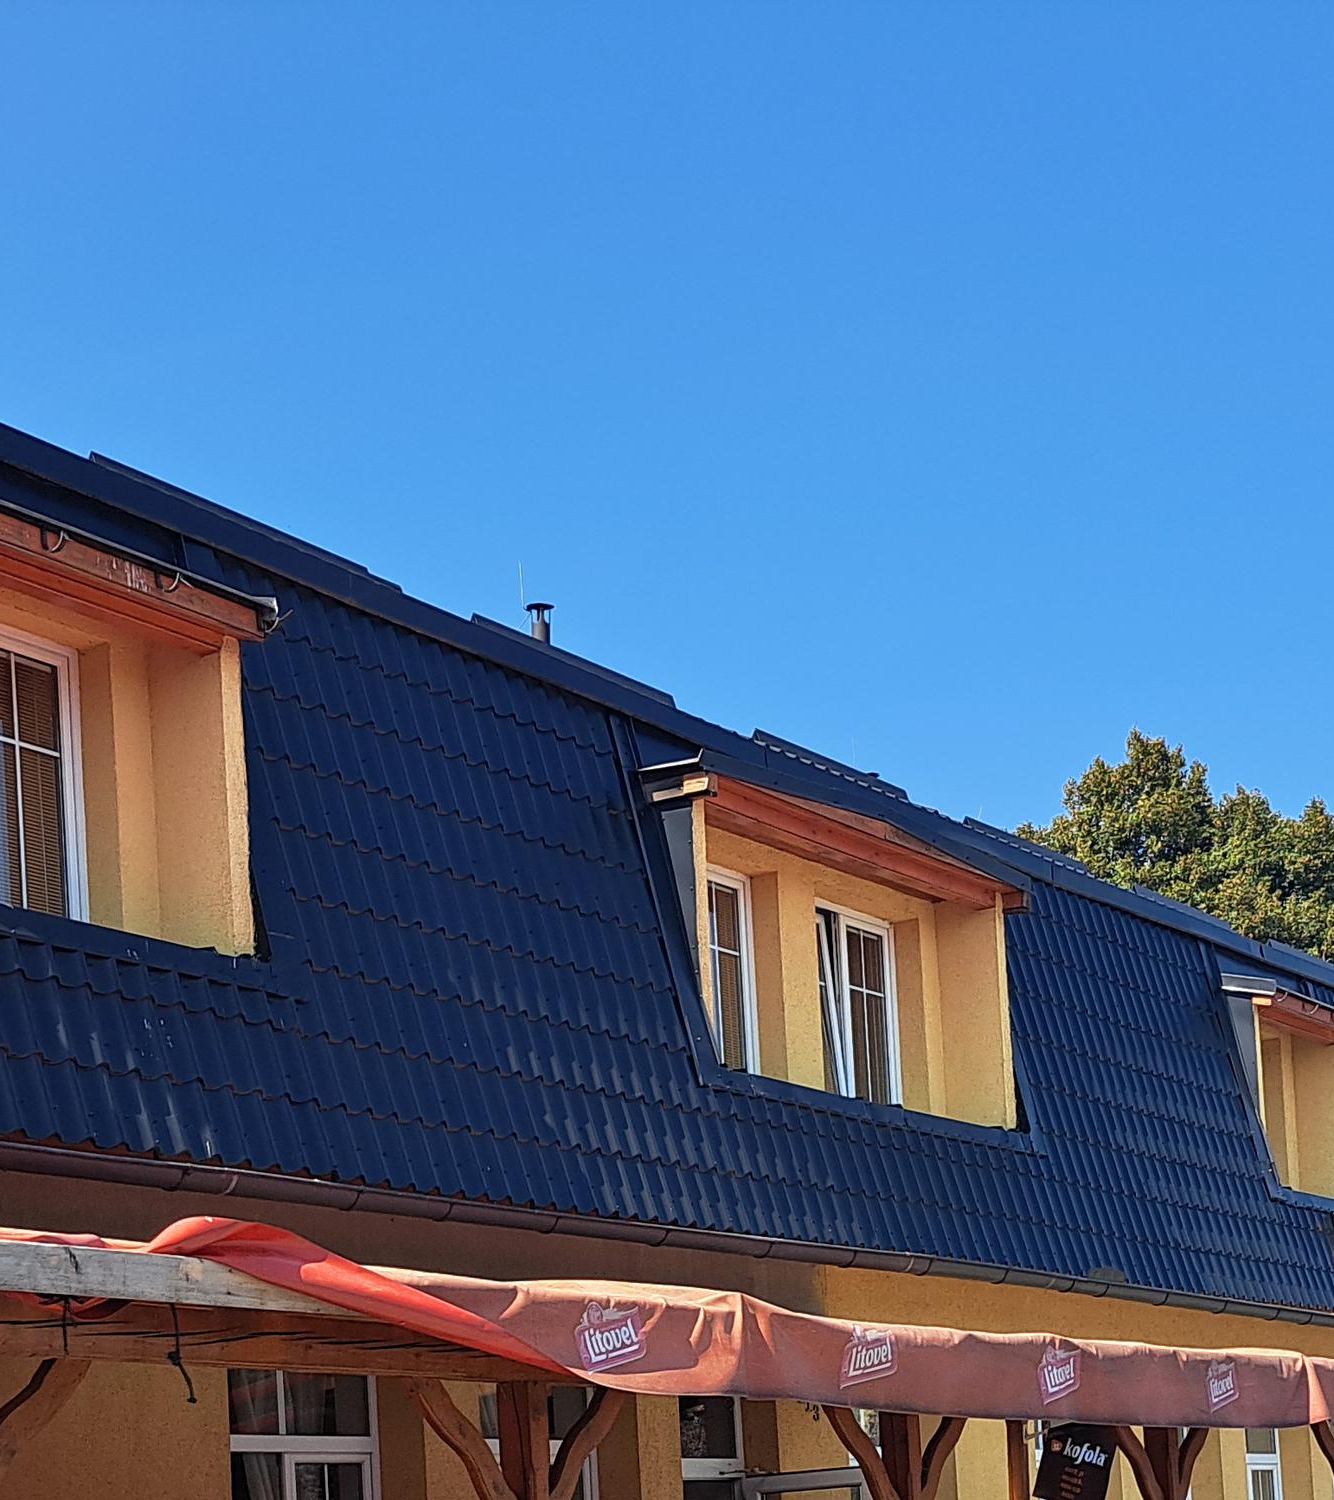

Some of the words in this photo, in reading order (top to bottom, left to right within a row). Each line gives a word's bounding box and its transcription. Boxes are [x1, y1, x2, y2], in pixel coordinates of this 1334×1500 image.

[584, 1318, 639, 1363] Litovel
[848, 1335, 892, 1377] Litovel
[1063, 1437, 1106, 1467] kofola
